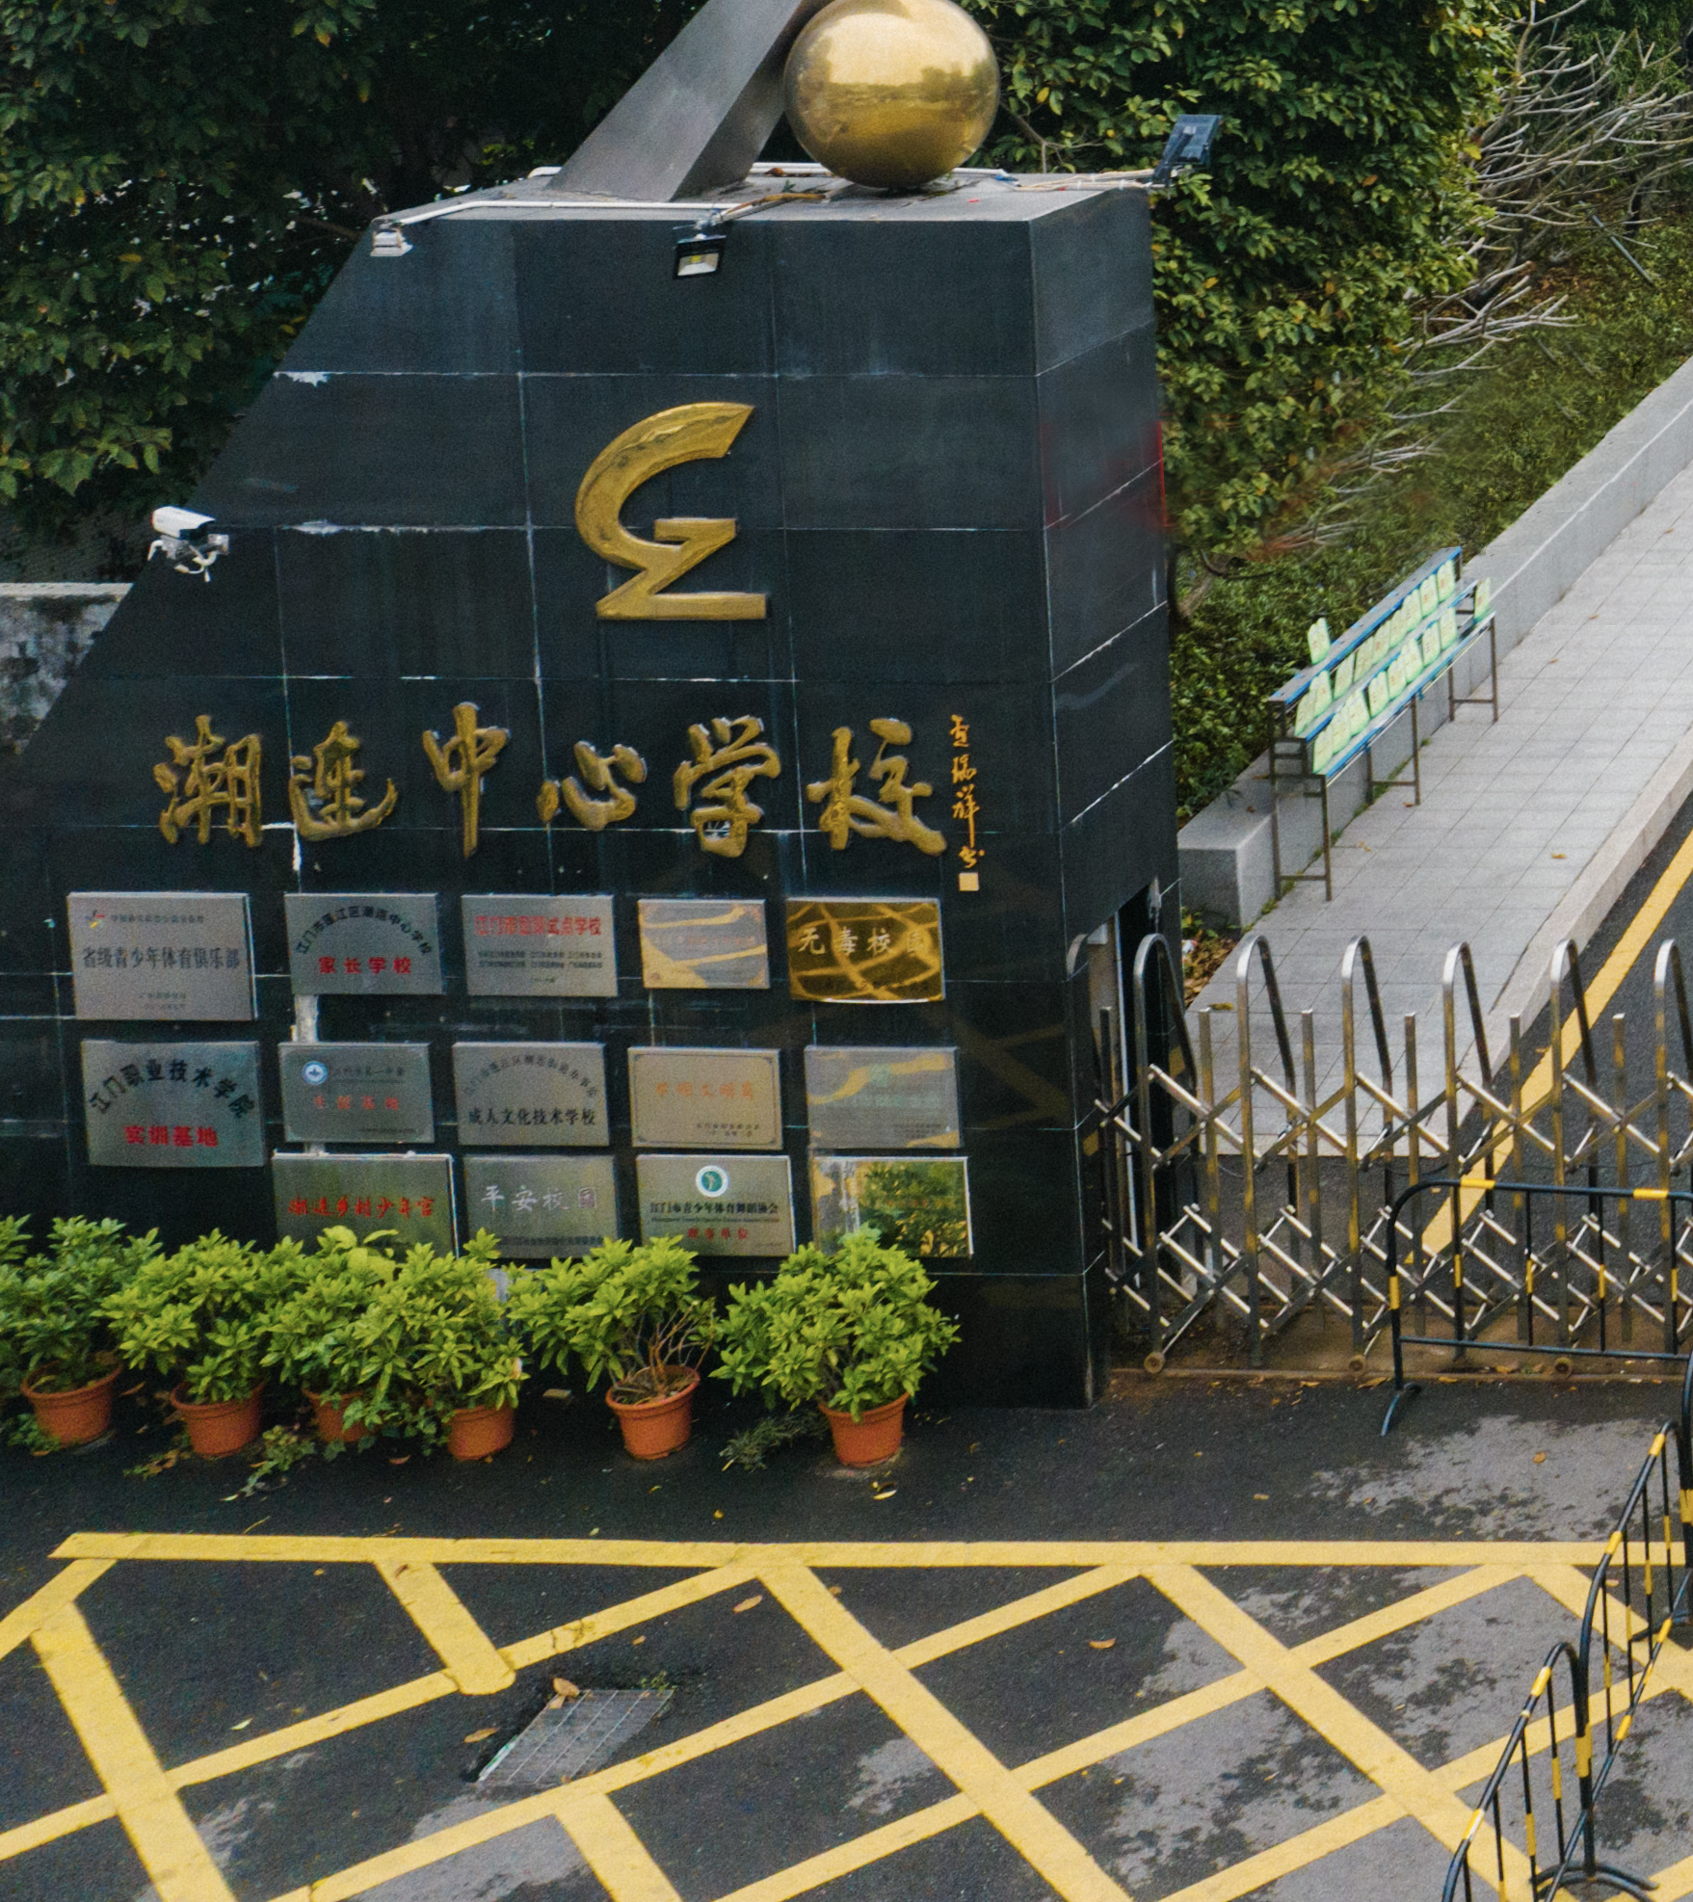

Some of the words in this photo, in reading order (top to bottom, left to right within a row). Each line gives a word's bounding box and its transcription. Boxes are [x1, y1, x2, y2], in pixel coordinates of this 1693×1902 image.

[153, 701, 947, 859] 潮连中心学校
[798, 926, 929, 958] 无毒校园
[83, 947, 240, 970] 省级青少年体育俱乐部
[318, 956, 412, 975] 家长学校
[89, 1059, 256, 1119] 江门职业技术学院
[468, 1107, 596, 1126] 成人文化技术学校
[124, 1125, 219, 1148] 实训基地
[480, 1184, 597, 1212] 平安校园
